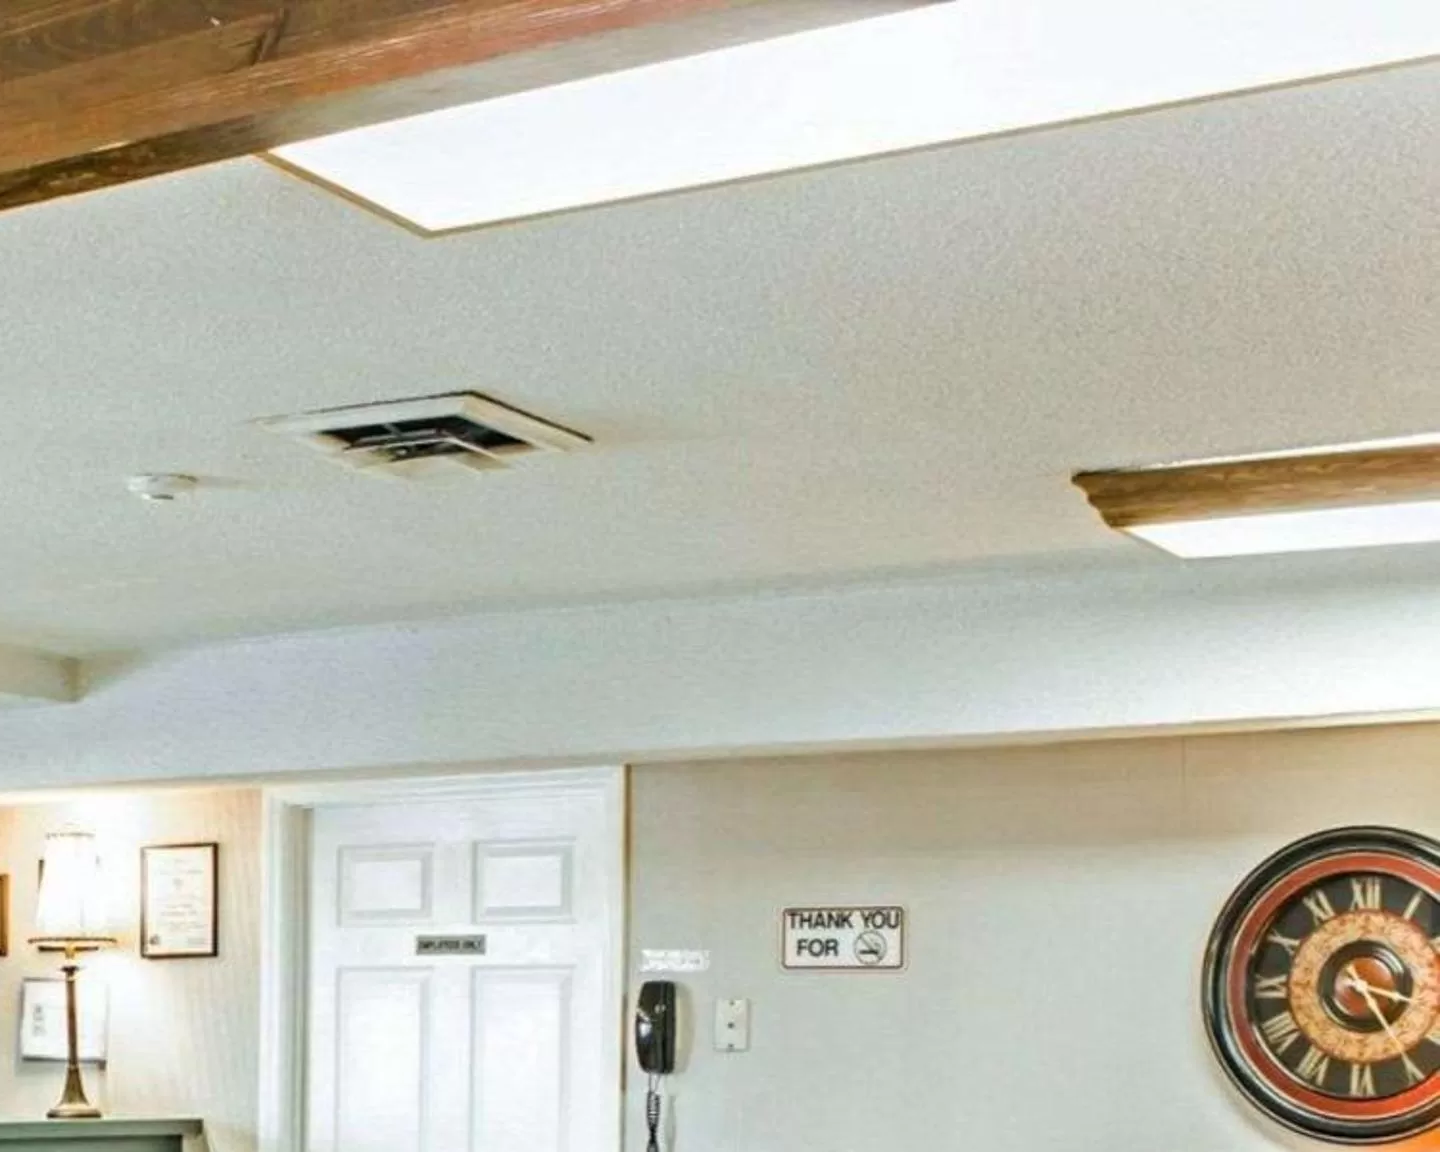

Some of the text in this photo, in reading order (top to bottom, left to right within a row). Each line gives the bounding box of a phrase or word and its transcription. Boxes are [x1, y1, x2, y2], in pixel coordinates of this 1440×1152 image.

[787, 910, 900, 929] THANK YOU
[795, 937, 840, 957] FOR
